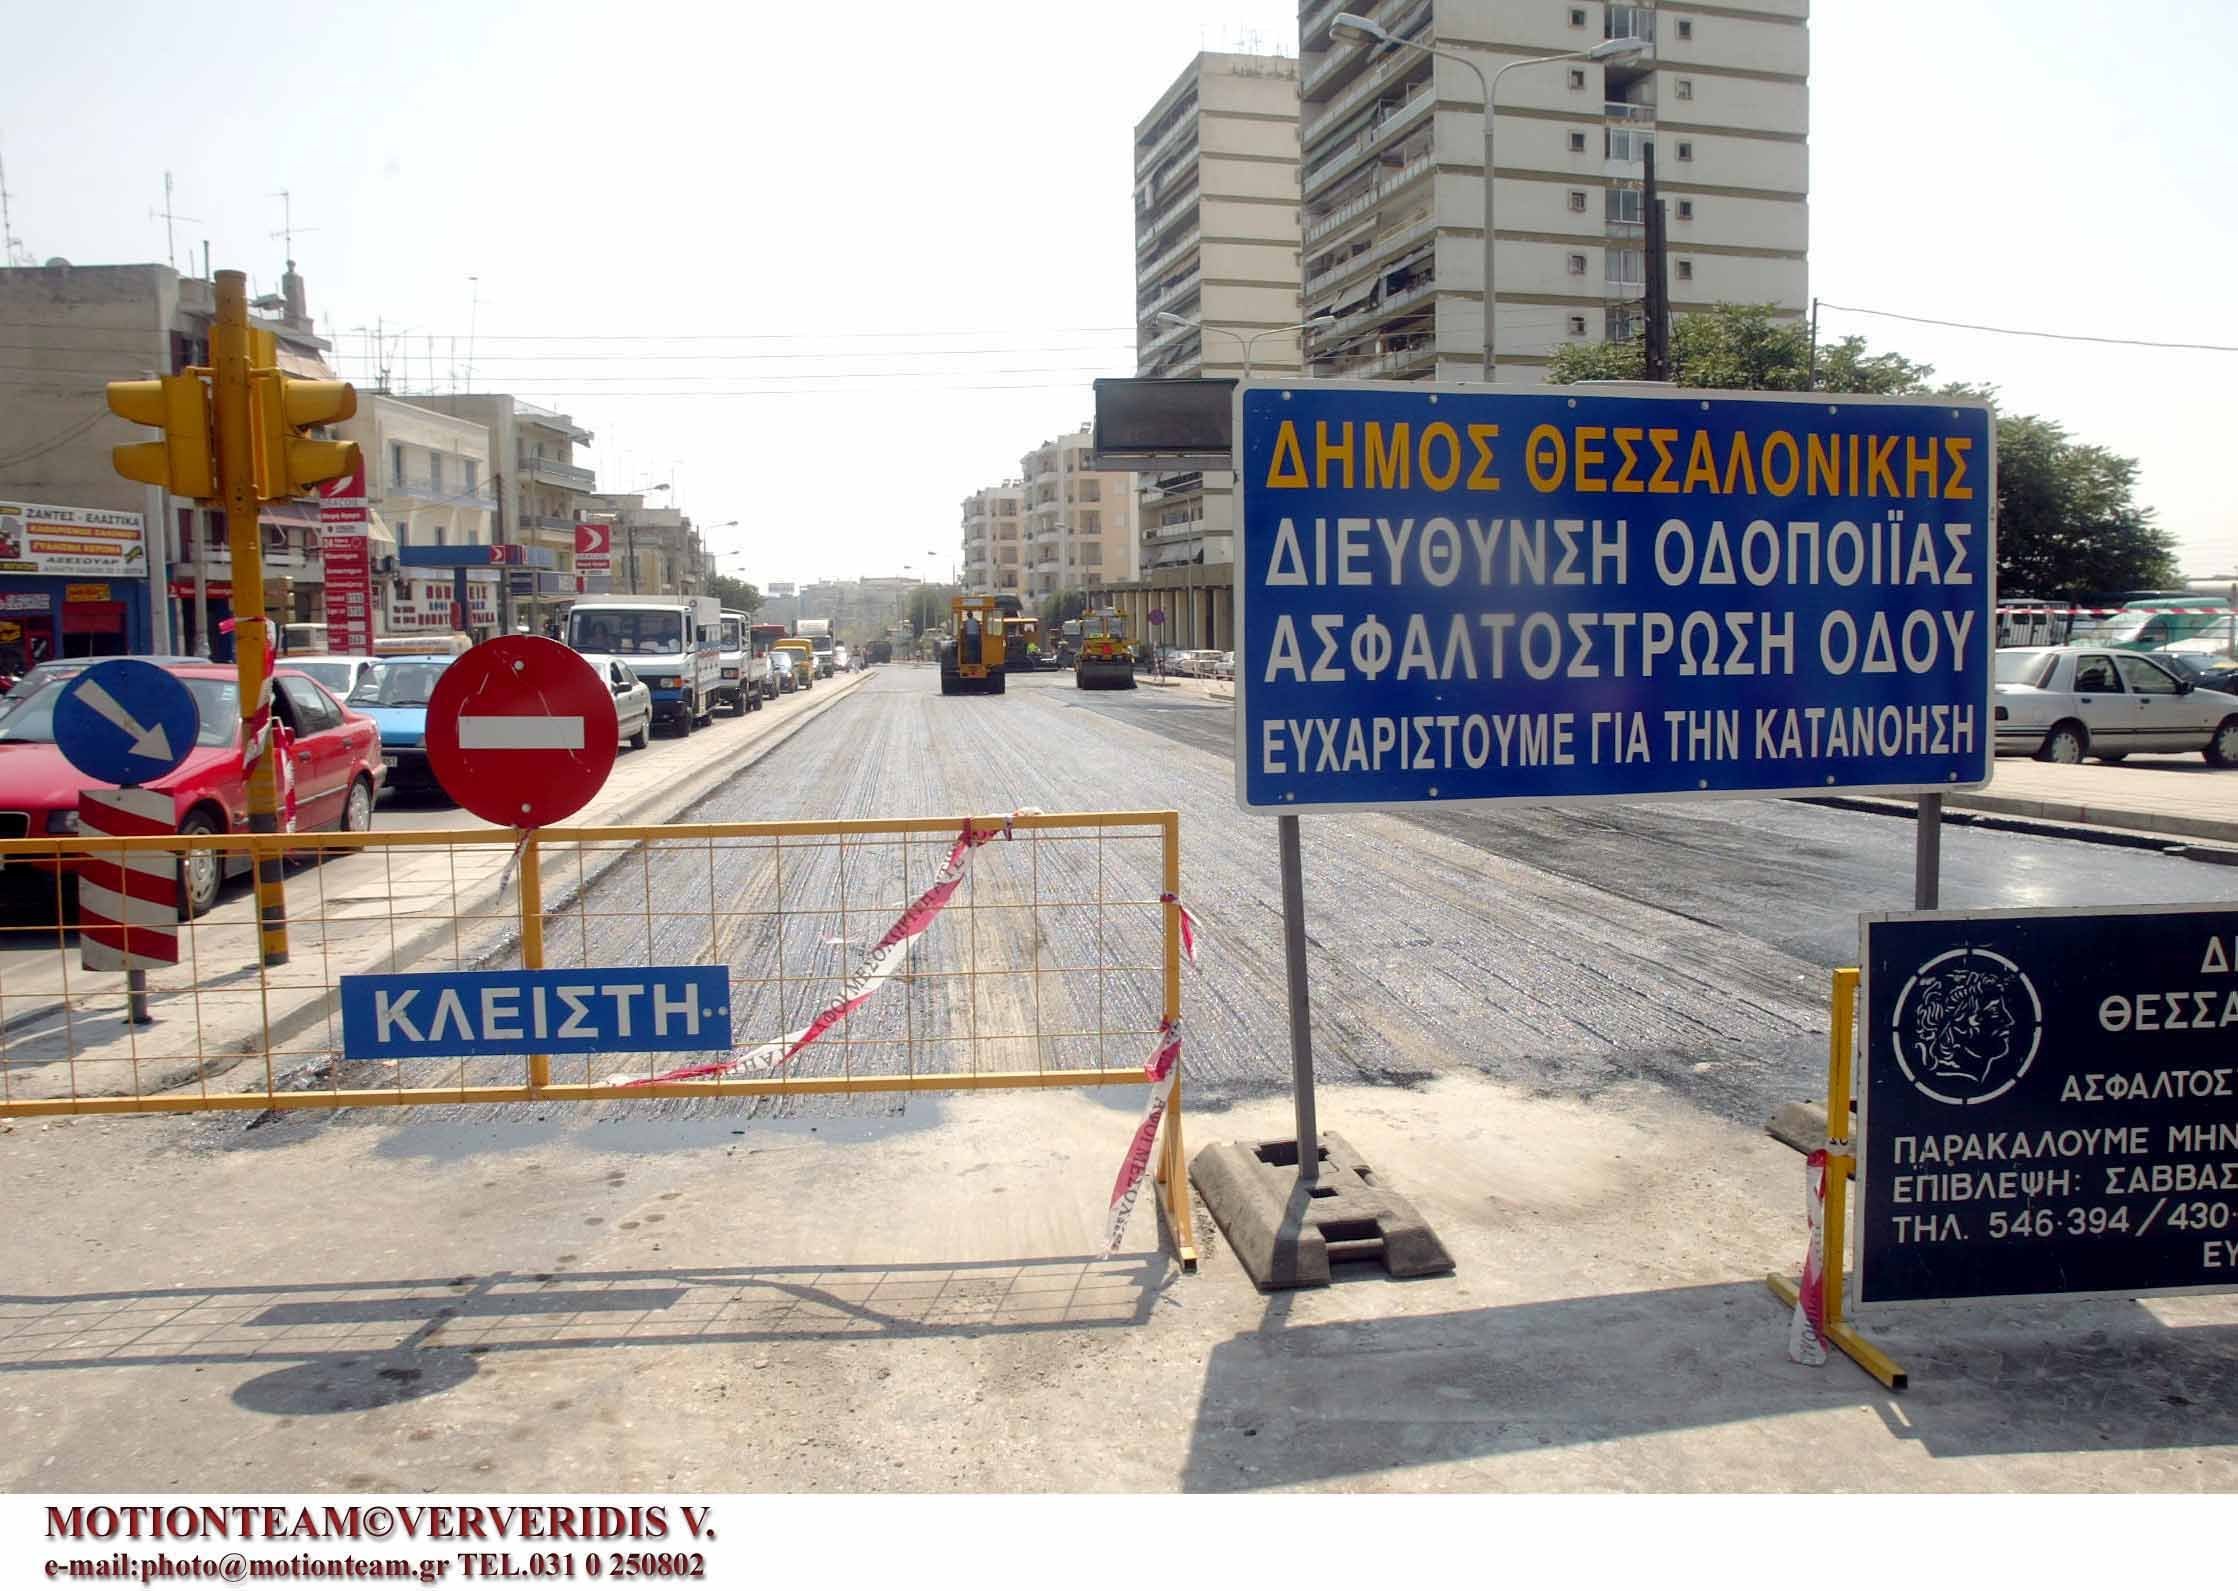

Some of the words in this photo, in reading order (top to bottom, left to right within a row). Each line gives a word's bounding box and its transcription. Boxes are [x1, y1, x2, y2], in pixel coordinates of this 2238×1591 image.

[1266, 420, 1500, 492] ΔΗΜΟΣ
[1525, 424, 1973, 499] ΘΕΣΣΑΛΟΝΙΚΗΣ
[1265, 517, 1627, 588] ΔΙΕΥΘΥΝΣΗ
[1654, 509, 1973, 586] ΟΔΟΠΟΙΪΑΣ
[1264, 610, 1795, 682] ΑΣΦΑΛΤΟΣΤΡΩΣΗ
[1820, 609, 1975, 675] ΟΔΟΥ
[1263, 713, 1576, 774] ΕΥΧΑΡΙΣΤΟΥΜΕ
[1591, 711, 1651, 765] ΓΙΑ
[1664, 709, 1739, 762] ΤΗΝ
[1755, 704, 1973, 759] ΚΑΤΑΝΟΗΣΗ
[375, 983, 700, 1043] ΚΛΕΙΣΤΗ
[2060, 1068, 2238, 1102] ΑΣΦΑΛΤΟΣ
[1894, 1127, 2150, 1164] ΠΑΡΑΚΑΛΟΥΜΕ
[2167, 1122, 2238, 1153] ΜΗΝ
[1893, 1169, 2081, 1203] ΕΠΙΒΛΕΨΗ:
[2105, 1162, 2238, 1194] ΣΑΒΒΑΣ
[1892, 1214, 1969, 1243] ΤΗΛ.
